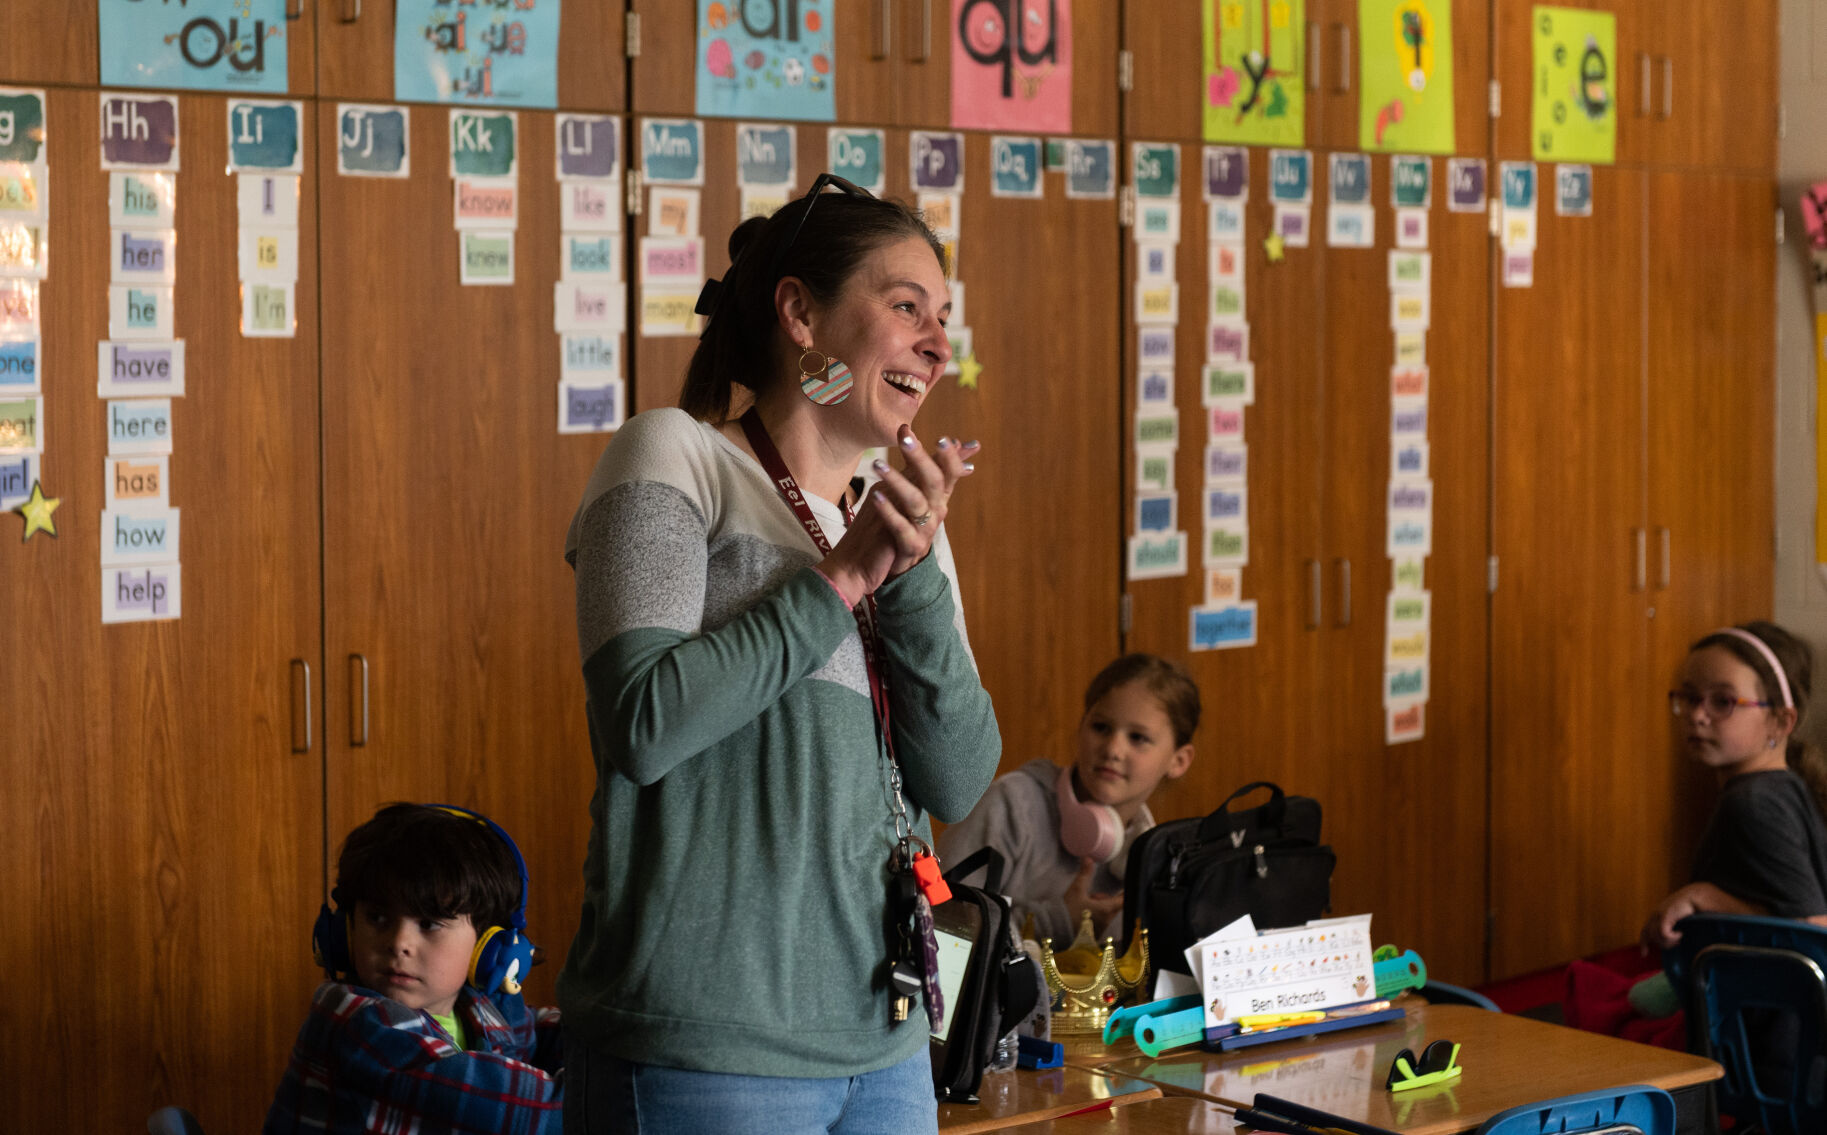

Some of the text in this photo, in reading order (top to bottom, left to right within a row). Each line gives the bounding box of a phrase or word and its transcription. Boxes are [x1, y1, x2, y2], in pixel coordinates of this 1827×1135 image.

[960, 0, 1057, 97] qu
[104, 101, 149, 142] Hh
[236, 106, 263, 144] Ii
[344, 112, 373, 157] Jj
[457, 118, 492, 152] Kk
[567, 120, 593, 155] Ll
[649, 128, 691, 158] Mm
[745, 131, 776, 164] Nn
[835, 136, 866, 167] Oo
[919, 137, 946, 178] Pp
[995, 143, 1029, 182] Qq
[1070, 145, 1096, 176] Rr
[1136, 147, 1161, 180] Ss
[125, 177, 158, 211] his
[264, 178, 274, 210] I
[459, 183, 513, 211] know
[573, 187, 604, 217] like
[122, 233, 163, 266] her
[259, 237, 277, 264] is
[571, 238, 609, 267] look
[128, 288, 156, 322] he
[256, 287, 286, 318] I'm
[575, 287, 606, 316] live
[113, 346, 170, 378] have
[567, 337, 613, 367] little
[113, 405, 167, 438] here
[116, 463, 158, 493] has
[115, 515, 166, 548] how
[778, 476, 830, 555] Eel Riv
[118, 570, 165, 614] help
[1252, 988, 1326, 1013] Ben Richards
